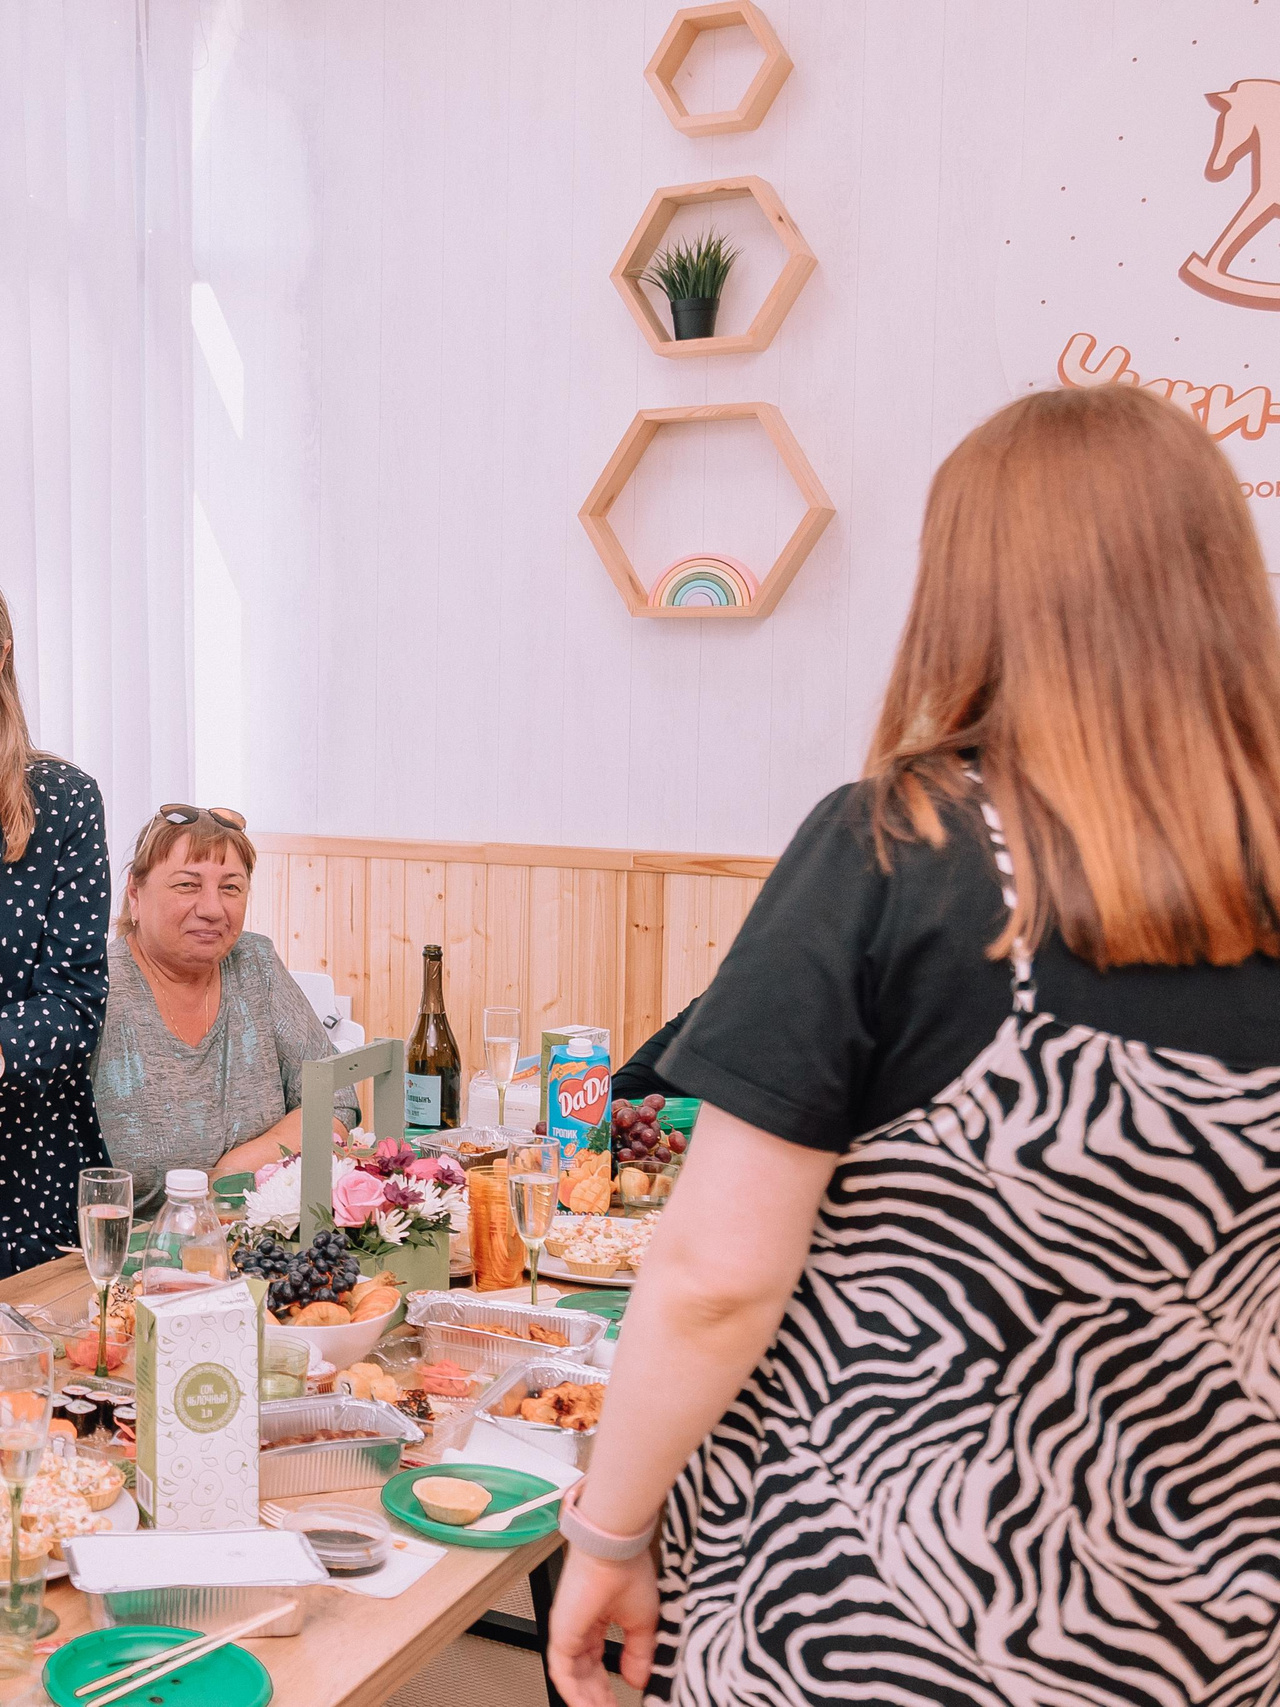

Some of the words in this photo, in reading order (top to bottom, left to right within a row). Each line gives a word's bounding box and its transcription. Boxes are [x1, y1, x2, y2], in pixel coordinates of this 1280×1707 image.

[558, 1075, 609, 1118] DaDa
[552, 1126, 577, 1139] ТРОПИК
[200, 1384, 214, 1395] СОК
[187, 1391, 228, 1407] ЯБЛОЧНЫЙ
